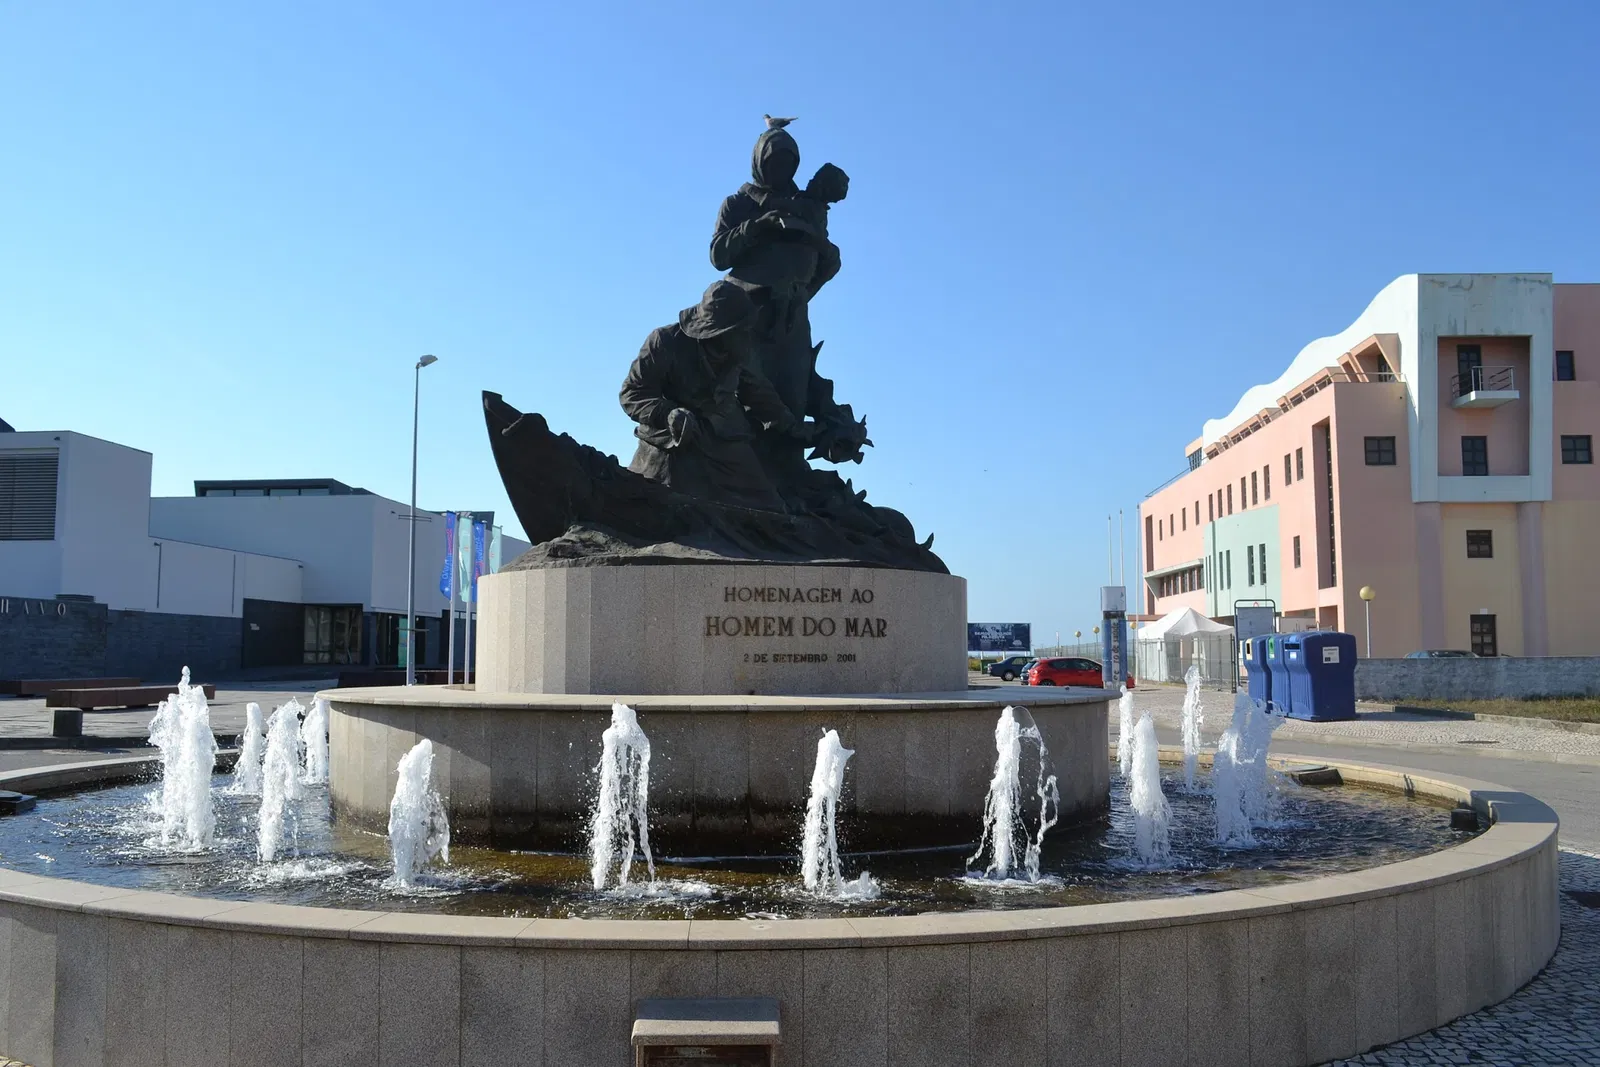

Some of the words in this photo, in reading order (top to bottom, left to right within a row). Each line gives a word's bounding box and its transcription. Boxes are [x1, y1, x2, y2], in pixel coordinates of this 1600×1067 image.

[723, 586, 842, 603] HOMENAGEM
[850, 588, 874, 604] AO
[705, 616, 795, 637] HOMEM
[801, 616, 836, 637] DO
[844, 617, 888, 638] MAR
[743, 653, 750, 663] 2
[753, 653, 768, 663] DE
[772, 653, 828, 663] SETEMBRO
[836, 653, 857, 663] 2001
